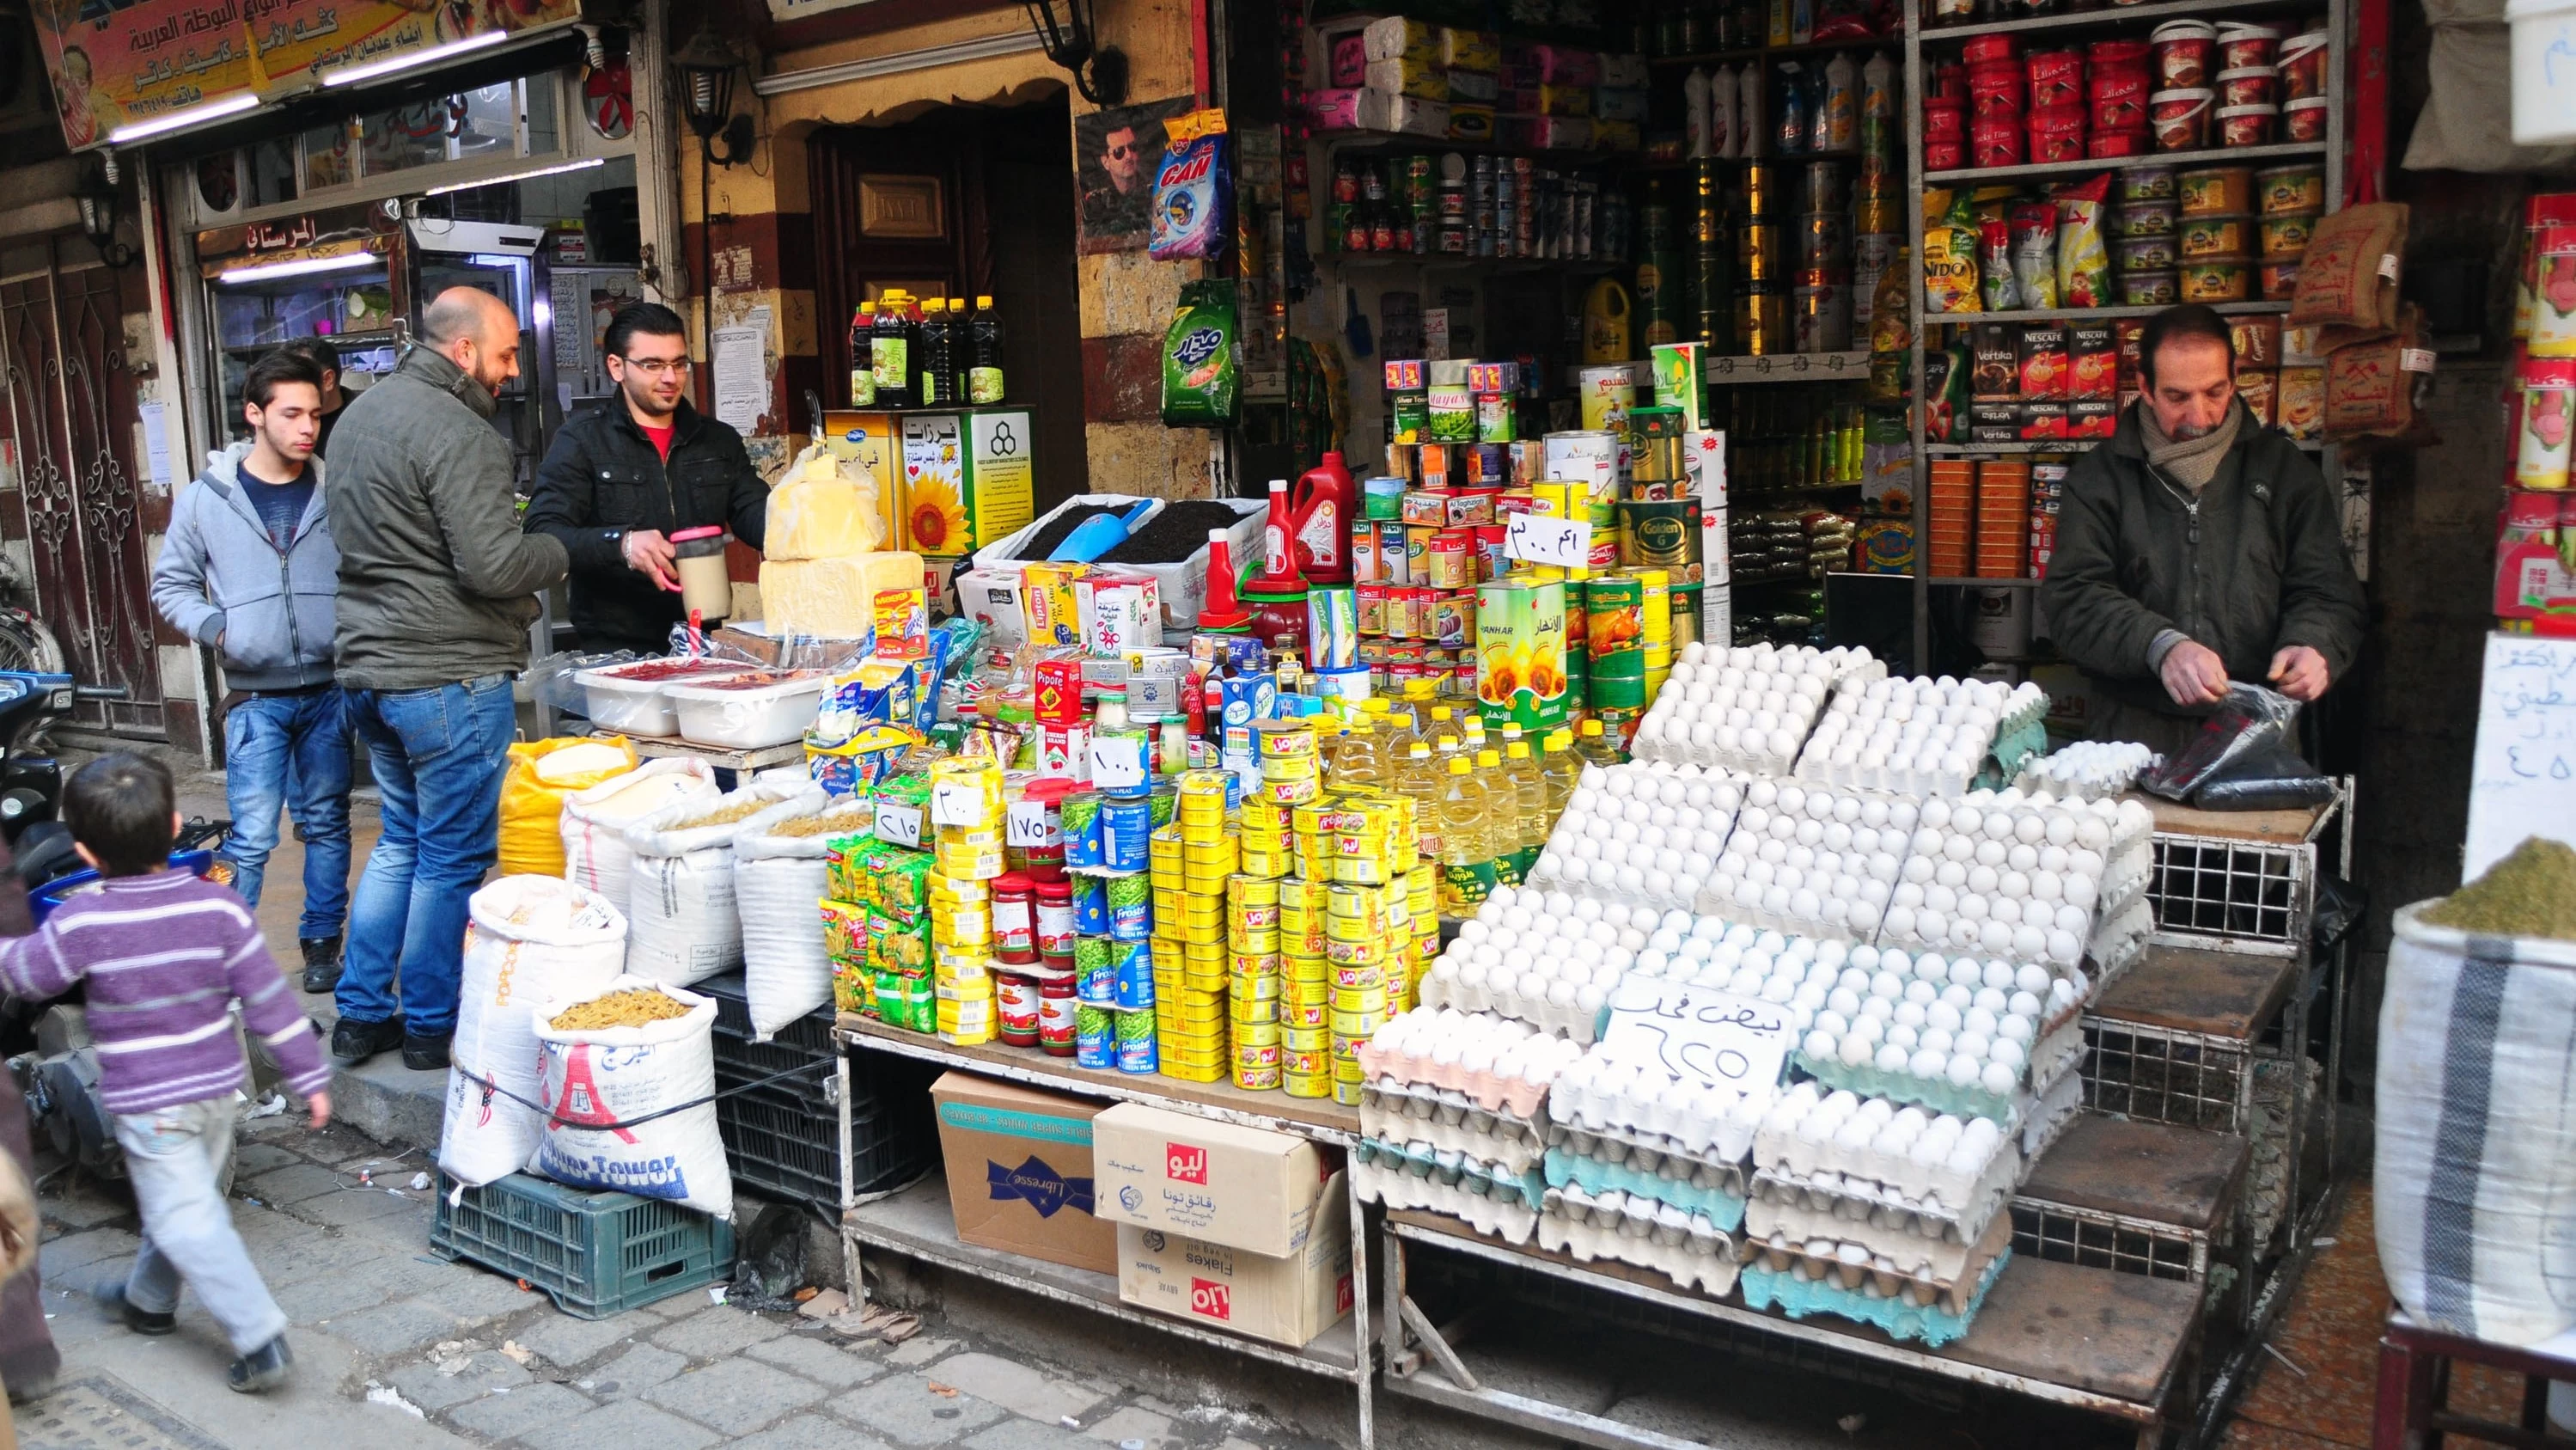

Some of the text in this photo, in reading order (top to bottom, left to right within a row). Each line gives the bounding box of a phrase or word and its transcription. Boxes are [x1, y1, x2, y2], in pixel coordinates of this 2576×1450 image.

[130, 16, 180, 52] العربية
[1160, 155, 1212, 188] CAN
[1171, 329, 1224, 359] مدار
[1978, 351, 2012, 361] Vertika
[905, 421, 957, 444] فرزات
[1645, 522, 1679, 534] Golden
[1657, 535, 1666, 546] G
[875, 590, 912, 606] Maggi
[1034, 589, 1047, 629] Lipton
[876, 645, 903, 657] الدجاج
[1037, 670, 1065, 688] Pipore
[1046, 731, 1068, 740] CHERRY
[879, 814, 918, 839] ٢١٥
[1010, 812, 1045, 841] ١٧٥
[1342, 838, 1359, 853] ليو
[1116, 930, 1135, 939] GREEN
[1092, 970, 1114, 982] Fros
[1091, 1058, 1106, 1068] PEAS
[1261, 1048, 1277, 1063] ليو
[1139, 1061, 1155, 1072] PEAS
[458, 1074, 468, 1109] CROWN
[944, 1108, 978, 1123] BOXES
[997, 1116, 1029, 1130] WINGS
[1031, 1121, 1064, 1135] SUPER
[1169, 1148, 1205, 1178] ليو
[1013, 1173, 1065, 1198] Libresse
[1163, 1187, 1217, 1214] رقائق تونا
[1203, 1245, 1221, 1257] veg
[1186, 1251, 1233, 1276] Flakes
